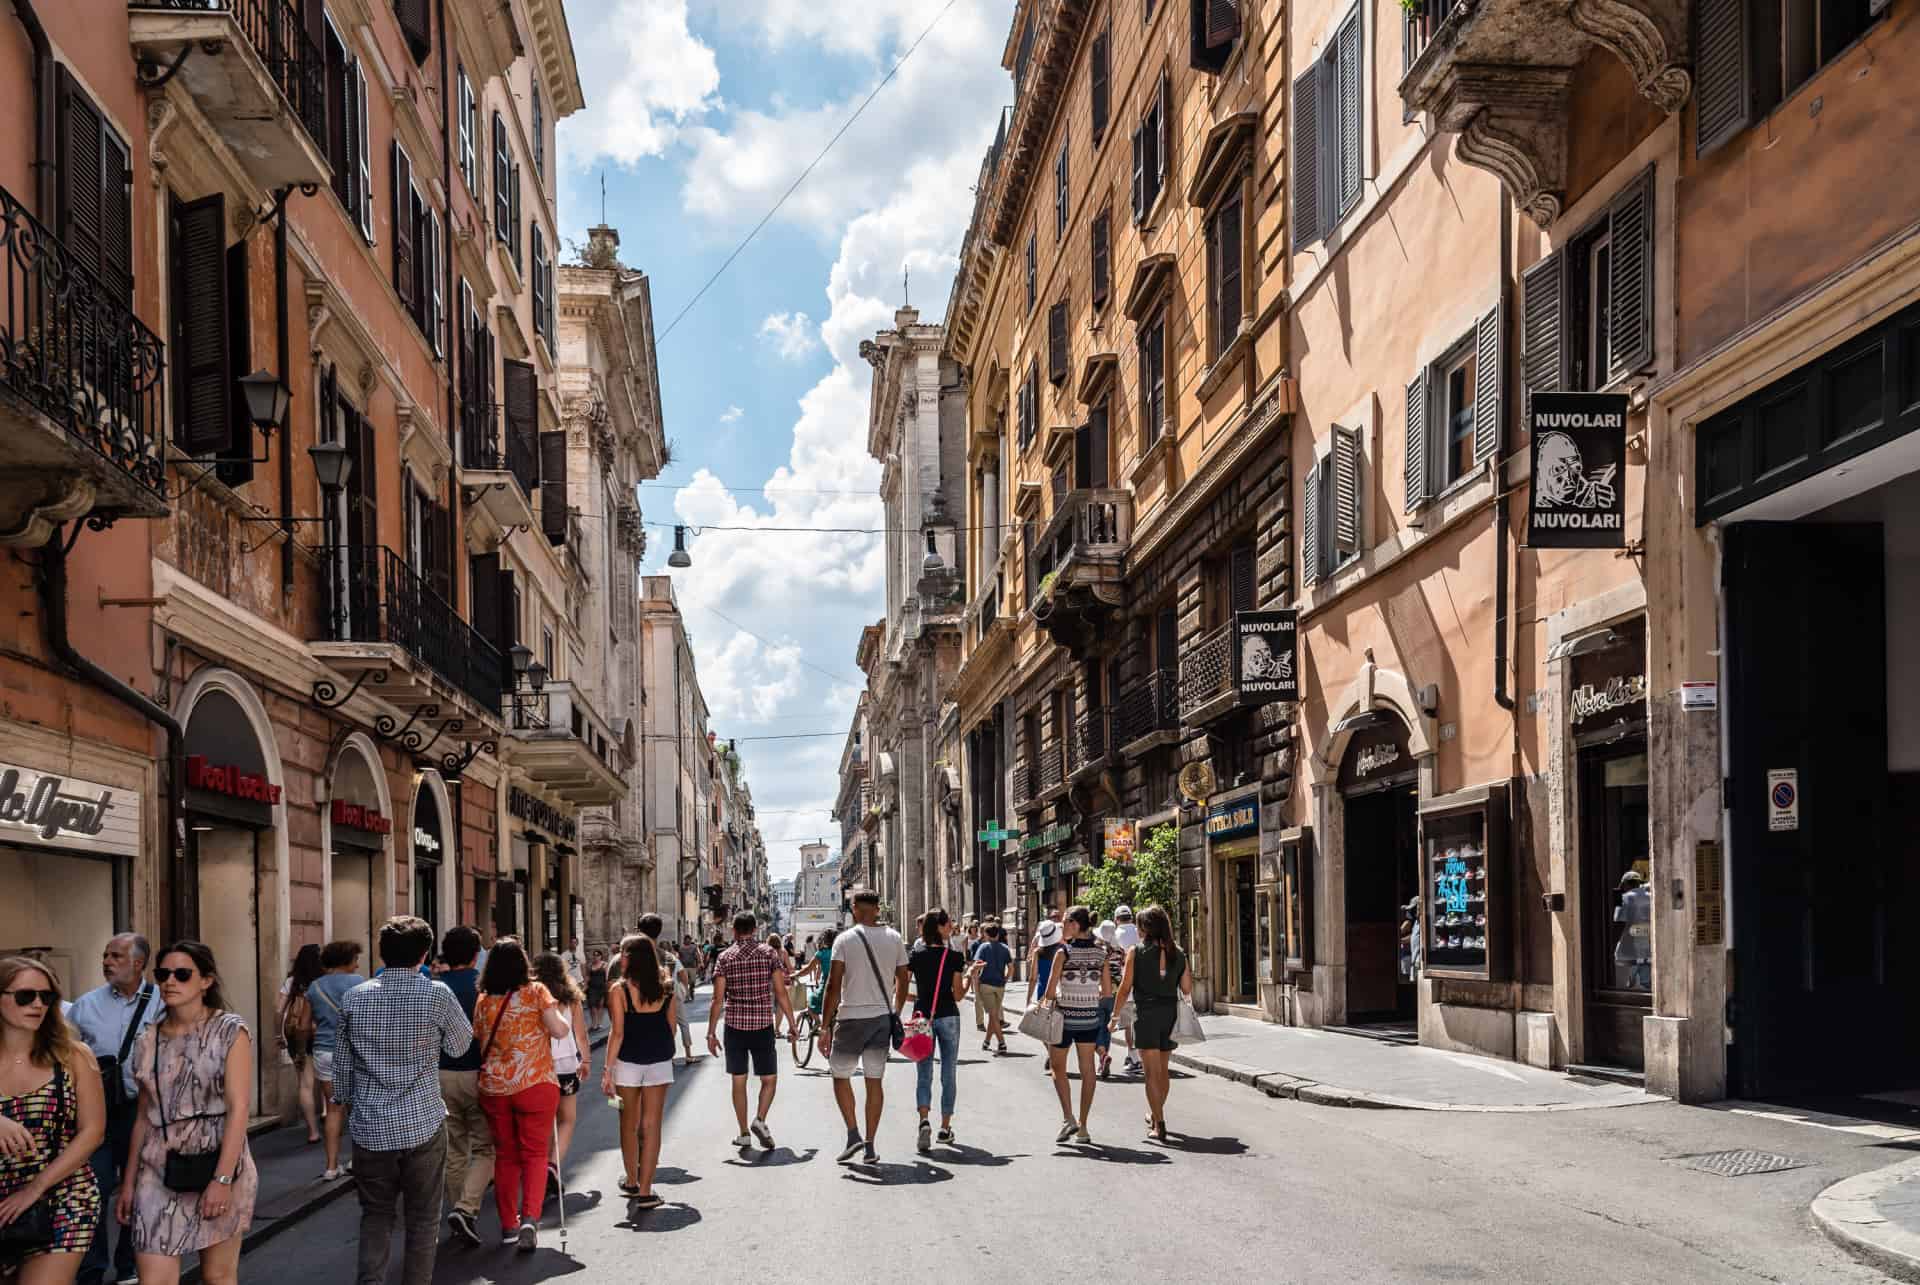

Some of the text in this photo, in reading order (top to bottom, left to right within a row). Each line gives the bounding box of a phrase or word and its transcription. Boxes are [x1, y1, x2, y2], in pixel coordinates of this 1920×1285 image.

[1535, 413, 1622, 428] NUVOLARI
[1533, 512, 1621, 528] NUVOLARI
[1240, 622, 1295, 633] NUVOLARI
[1241, 681, 1296, 692] NUVOLARI
[1112, 839, 1133, 847] DADA
